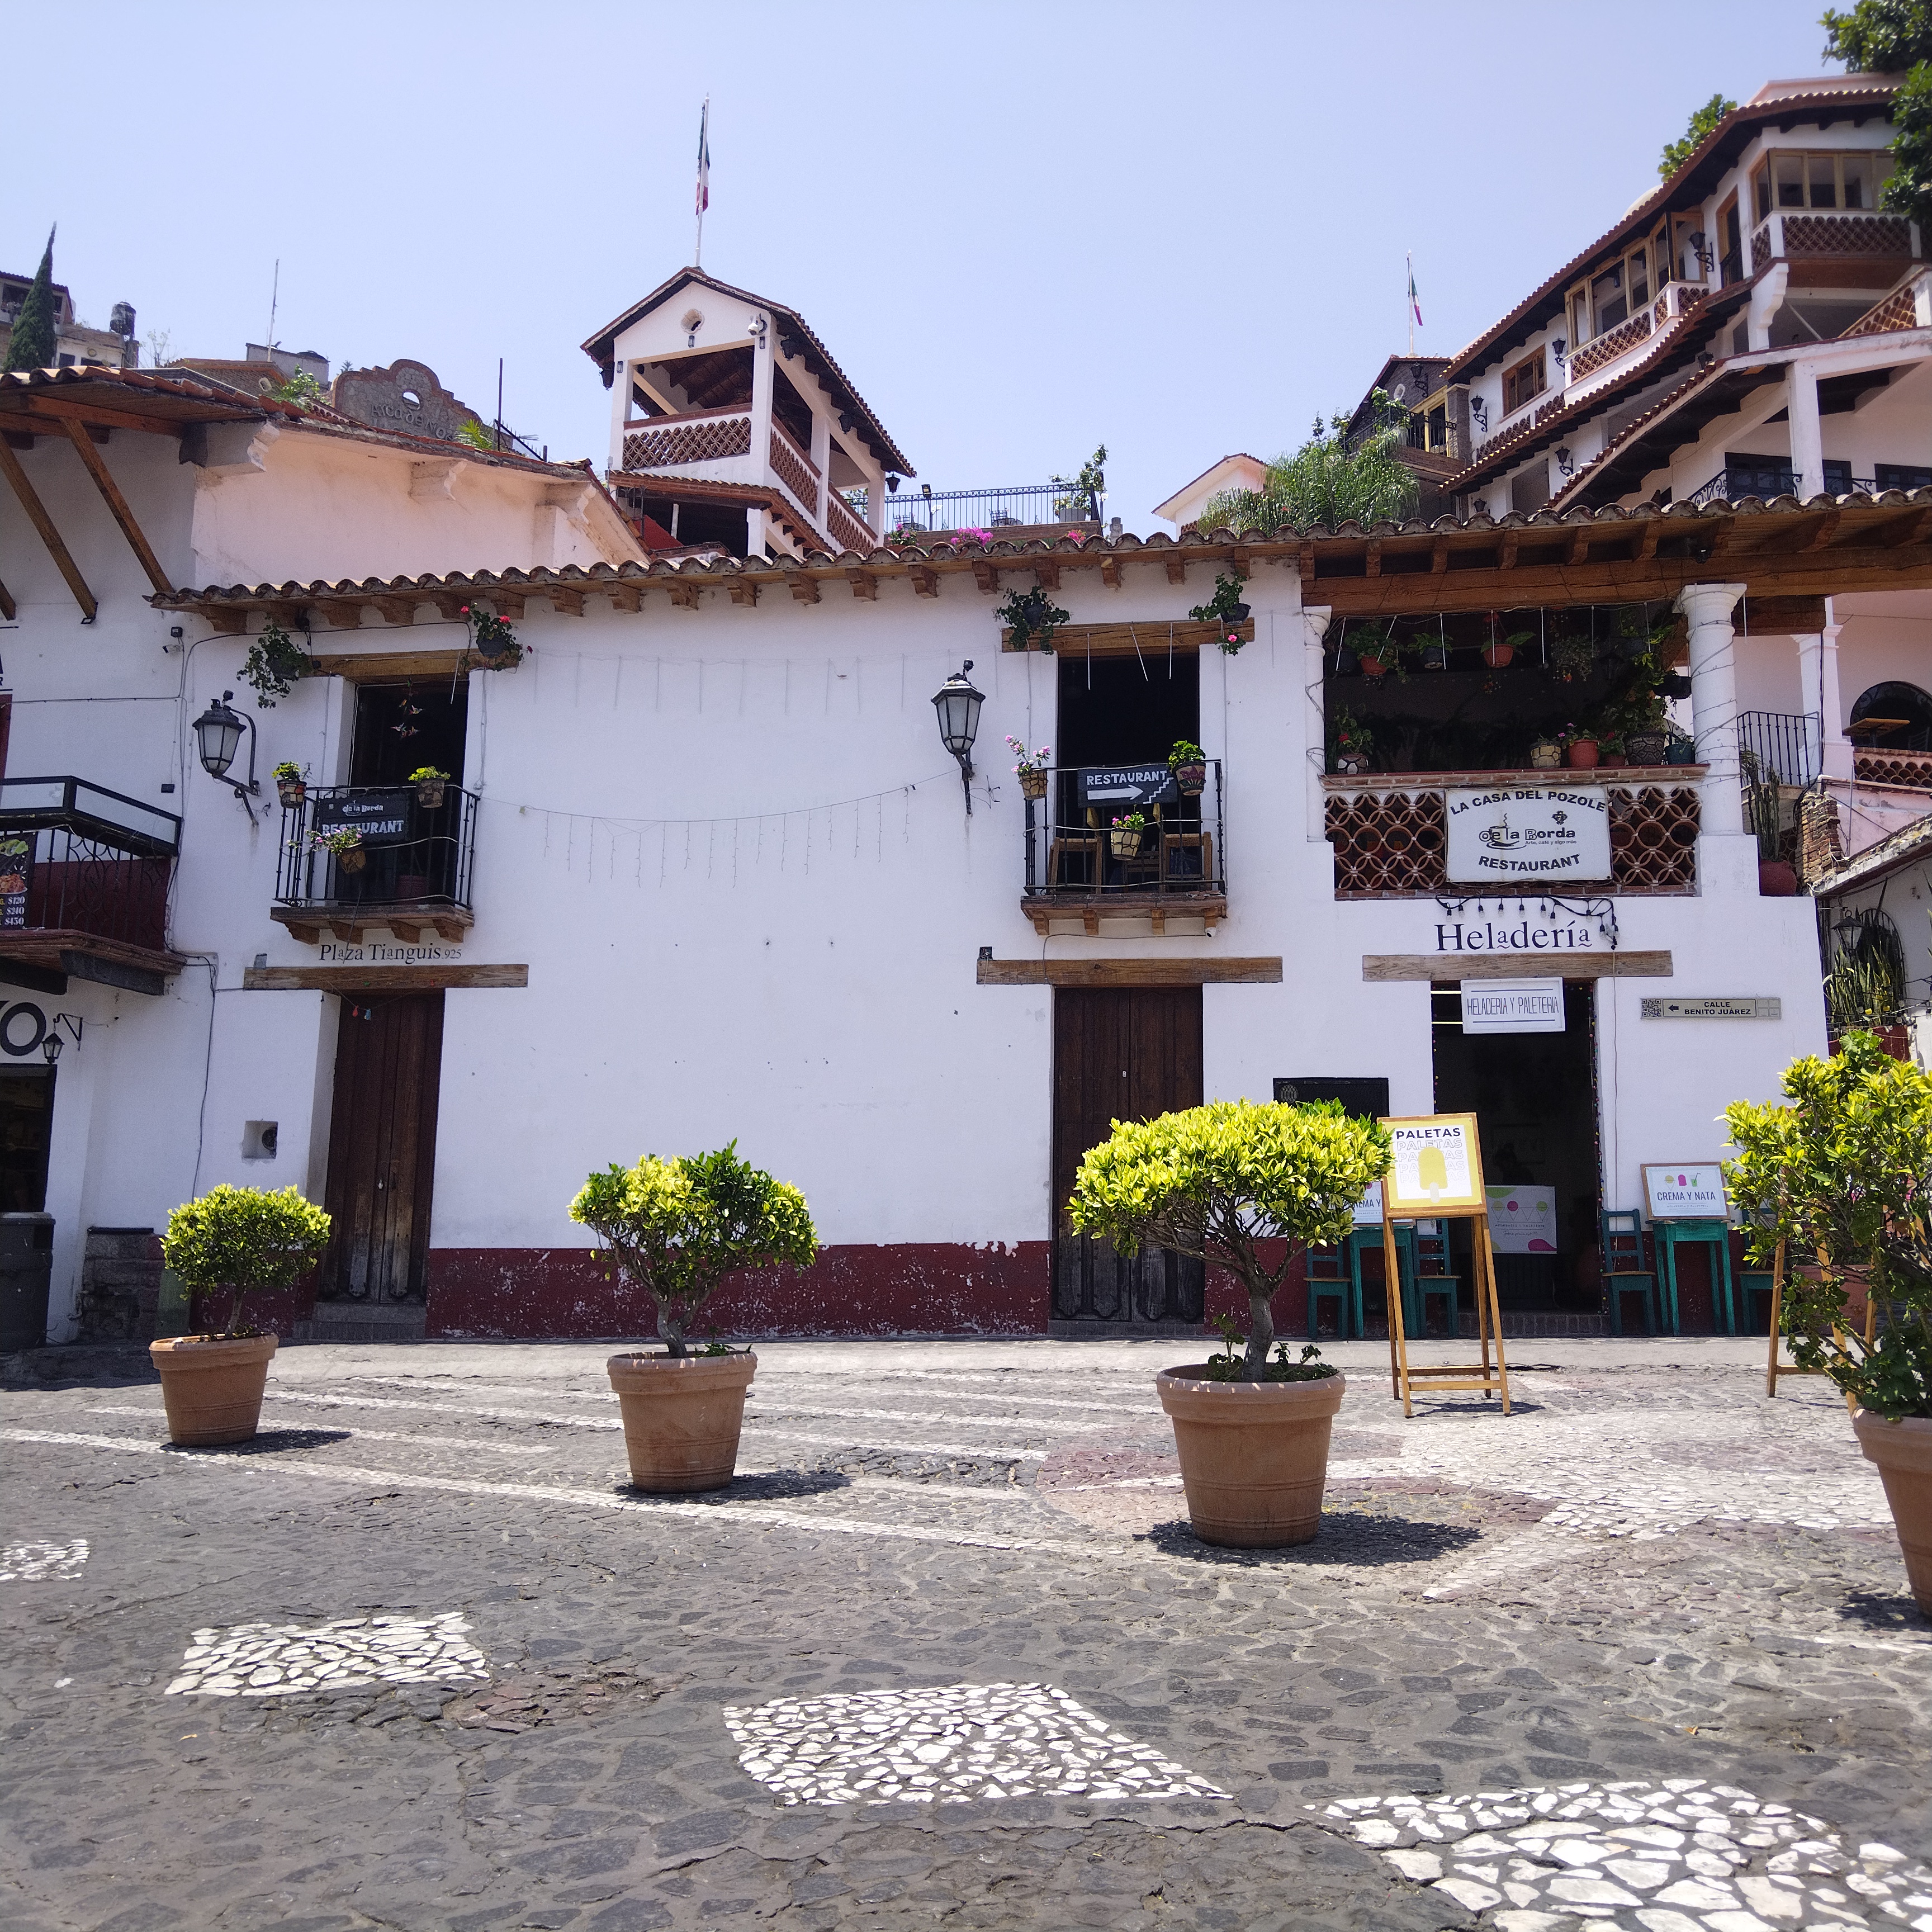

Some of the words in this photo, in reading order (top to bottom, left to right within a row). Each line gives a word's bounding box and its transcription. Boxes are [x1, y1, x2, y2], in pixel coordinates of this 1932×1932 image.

[1087, 770, 1167, 785] RESTAURANT
[1450, 802, 1469, 815] LA
[1472, 792, 1511, 807] CASA
[1516, 790, 1543, 799] DEL
[1548, 791, 1606, 812] POZOLE
[1525, 827, 1575, 840] Borda
[1479, 854, 1580, 871] RESTAURANT
[1434, 921, 1592, 950] Heladería
[319, 944, 363, 960] Plaza
[1467, 998, 1508, 1015] HELADERIA
[1509, 998, 1516, 1014] Y
[1518, 996, 1559, 1014] PALETERIA
[1396, 1128, 1461, 1139] PALETAS
[1398, 1150, 1464, 1162] PAAS
[1399, 1161, 1465, 1173] PAAS
[1376, 1199, 1381, 1207] Y
[1658, 1192, 1685, 1201] CREMA
[1687, 1192, 1692, 1200] Y
[1694, 1192, 1716, 1200] NATA
